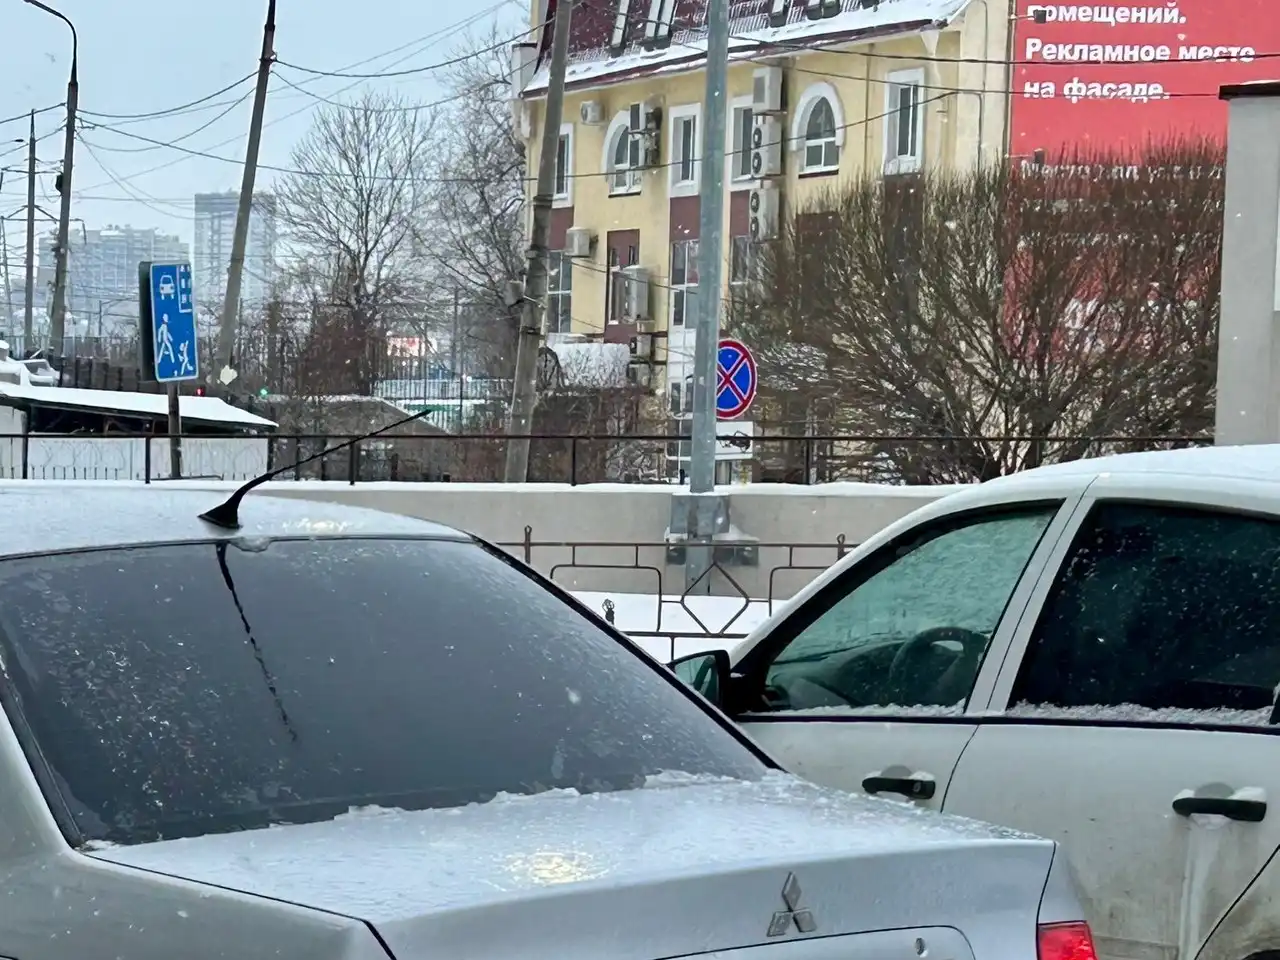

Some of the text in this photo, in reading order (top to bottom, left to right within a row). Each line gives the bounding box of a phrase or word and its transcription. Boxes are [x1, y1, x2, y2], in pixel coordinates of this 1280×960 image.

[1025, 38, 1255, 62] Рекламное место
[1023, 77, 1170, 104] на фасаде.
